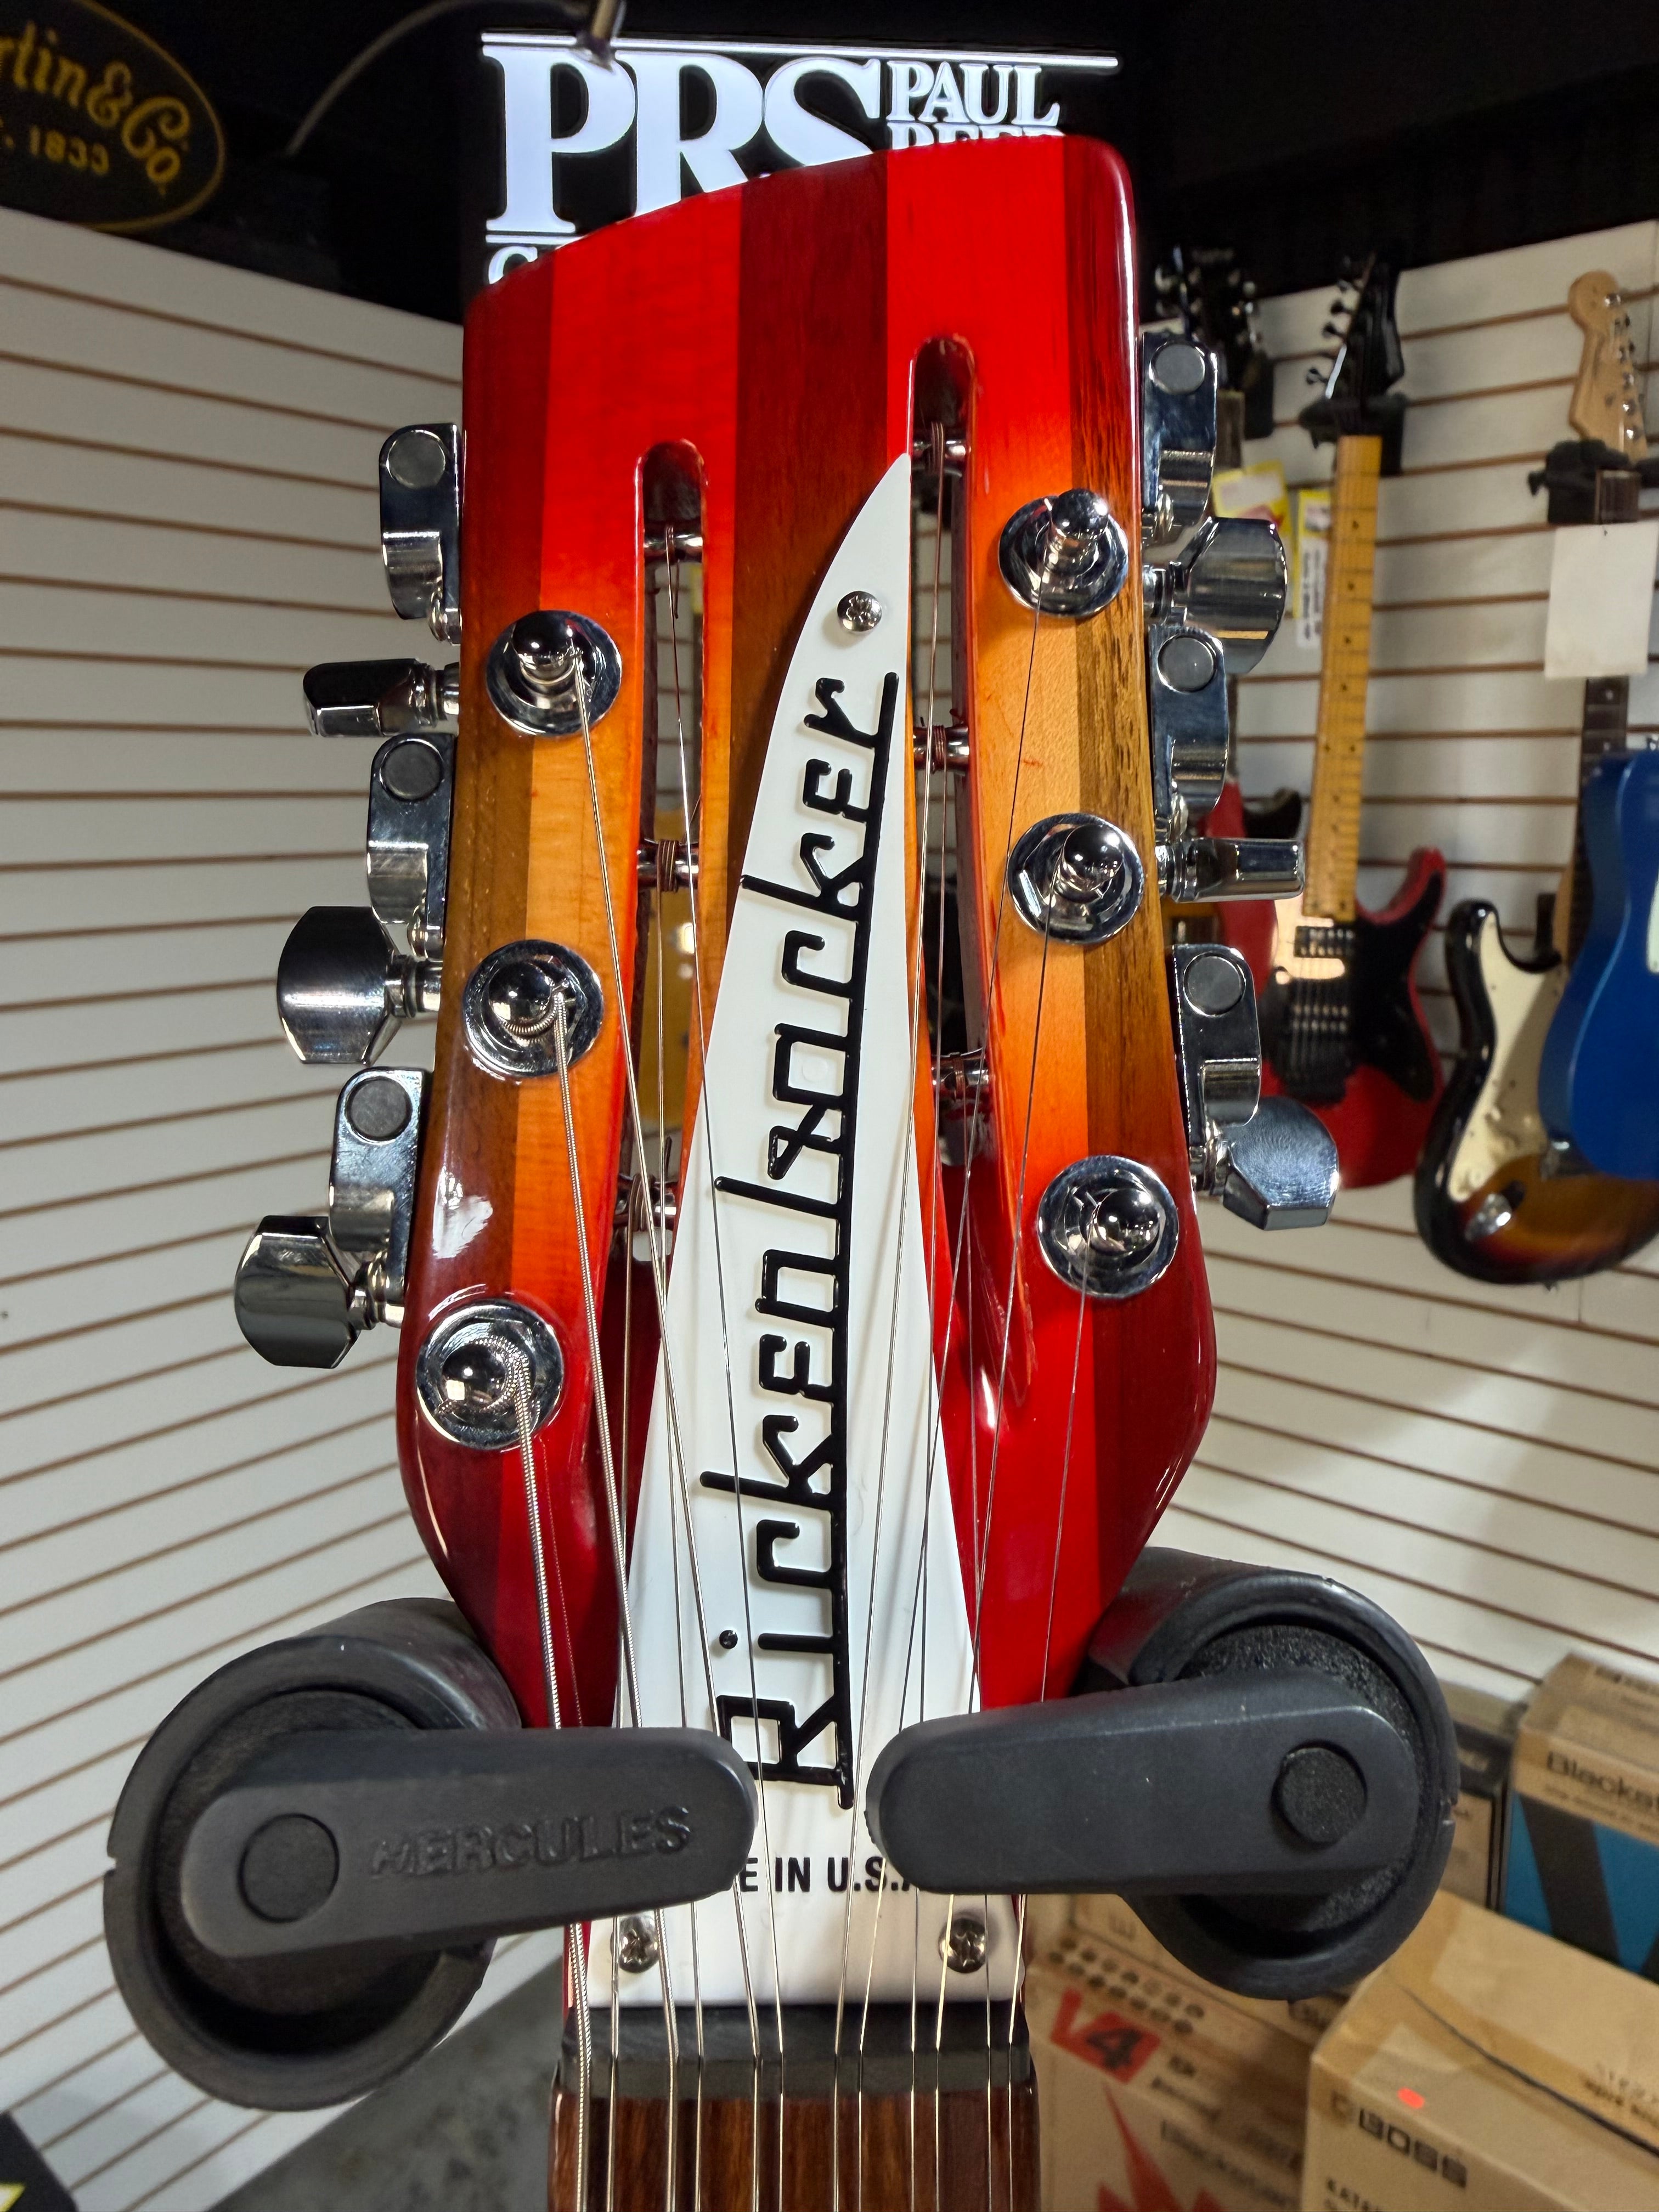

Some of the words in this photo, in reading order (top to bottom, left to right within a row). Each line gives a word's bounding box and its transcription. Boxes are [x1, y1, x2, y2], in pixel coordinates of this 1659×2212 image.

[886, 60, 1060, 127] PAUL
[483, 46, 881, 233] PRS
[699, 672, 899, 1809] Rickenbacker
[371, 1806, 692, 1877] HERCULES
[775, 1857, 810, 1892] IN
